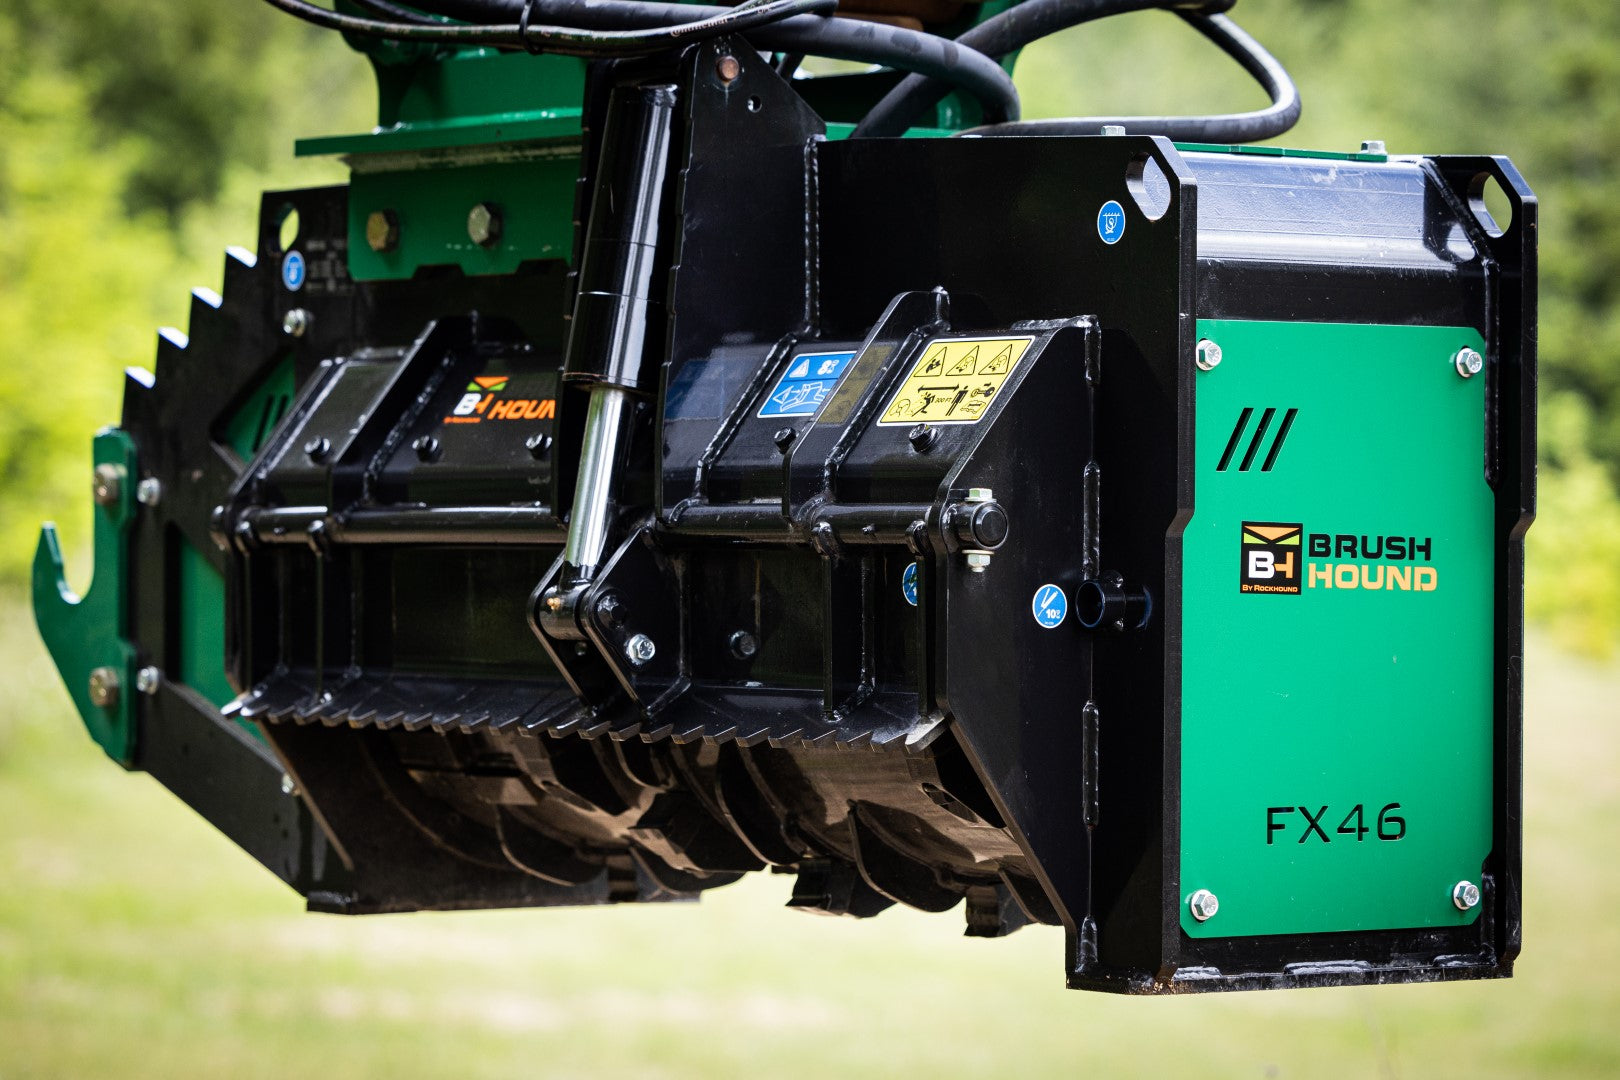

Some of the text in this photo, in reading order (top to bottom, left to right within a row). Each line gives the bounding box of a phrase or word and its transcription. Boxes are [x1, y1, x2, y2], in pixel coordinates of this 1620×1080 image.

[487, 399, 556, 420] HOUN
[1308, 533, 1432, 561] BRUSH
[1248, 550, 1294, 579] BH
[1308, 563, 1438, 591] HOUND
[1266, 802, 1406, 845] FX46
